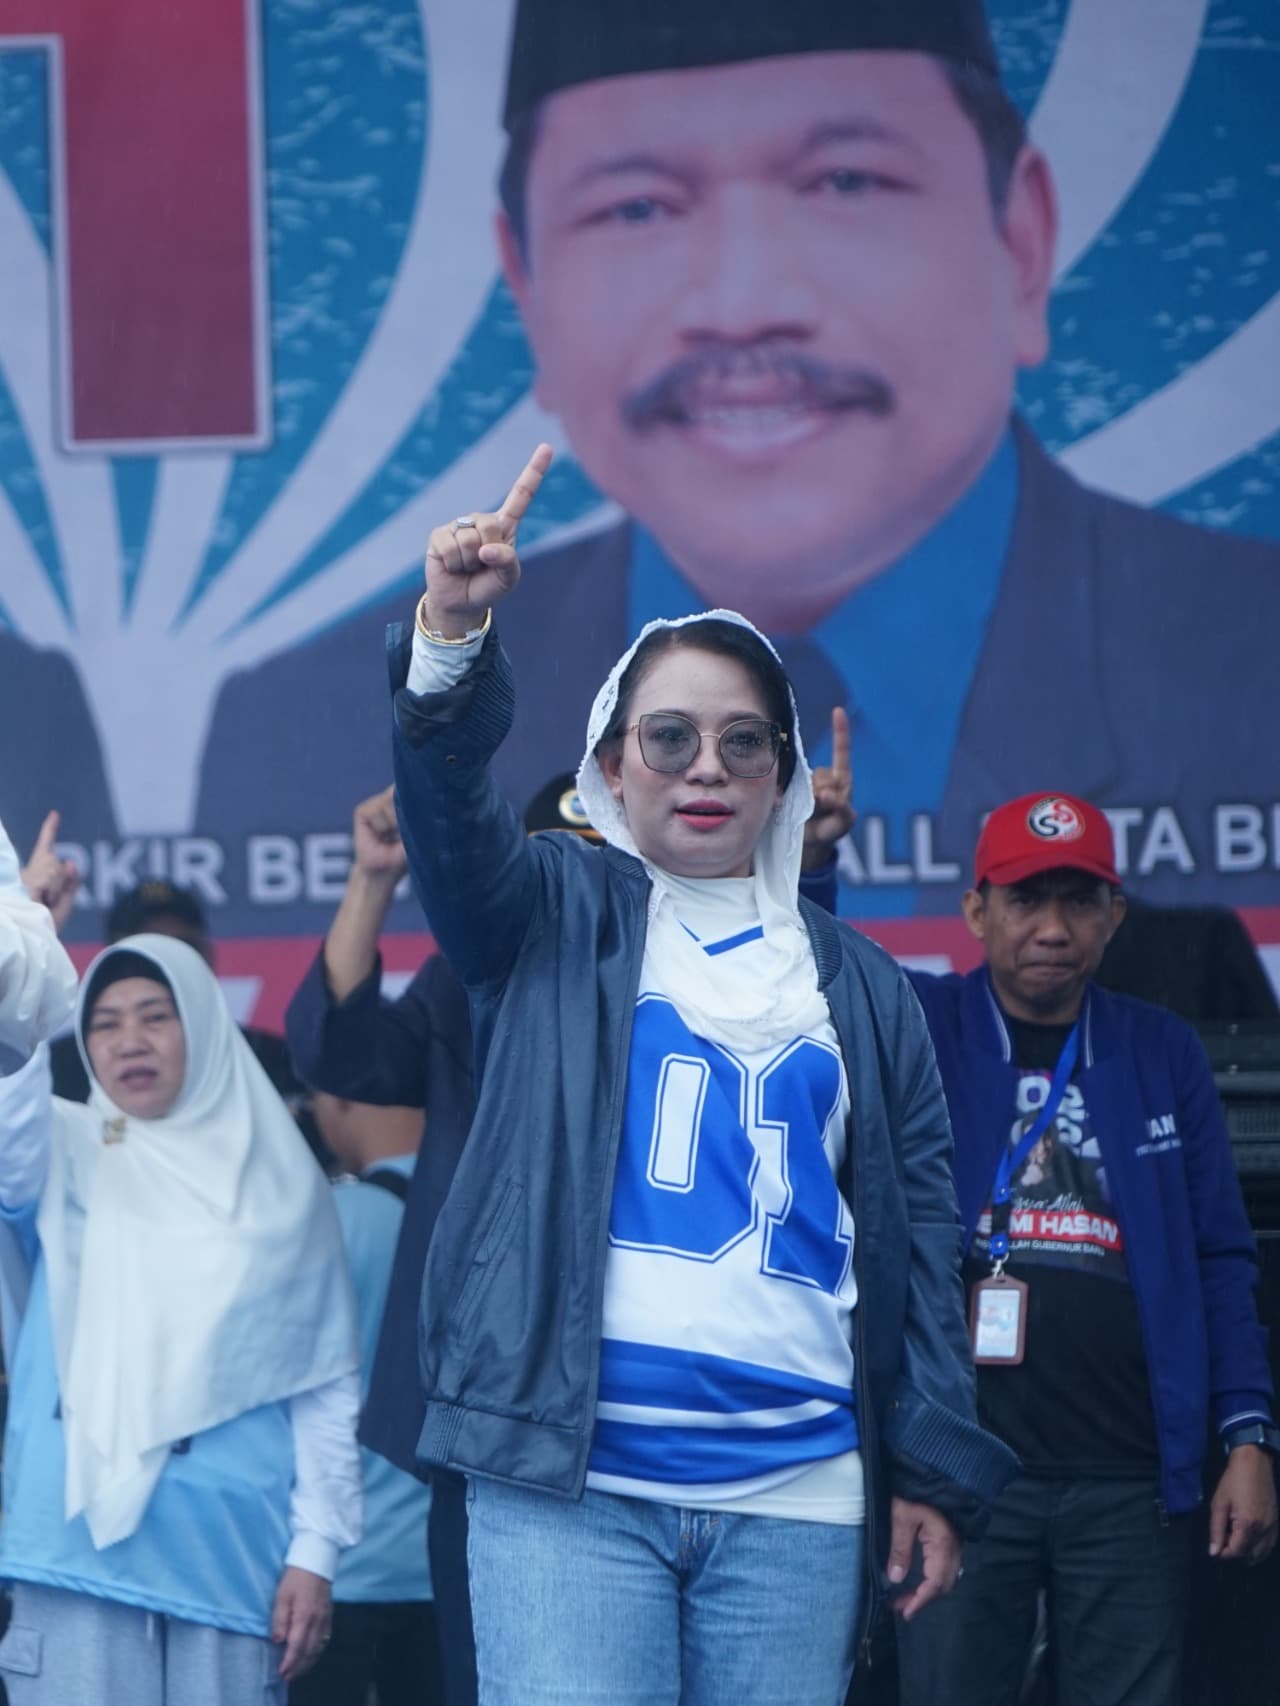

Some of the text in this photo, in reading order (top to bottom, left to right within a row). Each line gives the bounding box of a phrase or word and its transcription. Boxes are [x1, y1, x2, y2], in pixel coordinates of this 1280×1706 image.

[53, 835, 226, 907] RKIR
[247, 832, 411, 902] BE
[1112, 806, 1196, 876] TA
[1215, 803, 1280, 873] B
[609, 991, 854, 1300] 01
[1144, 1113, 1177, 1140] AN
[1039, 1215, 1118, 1244] HASAN
